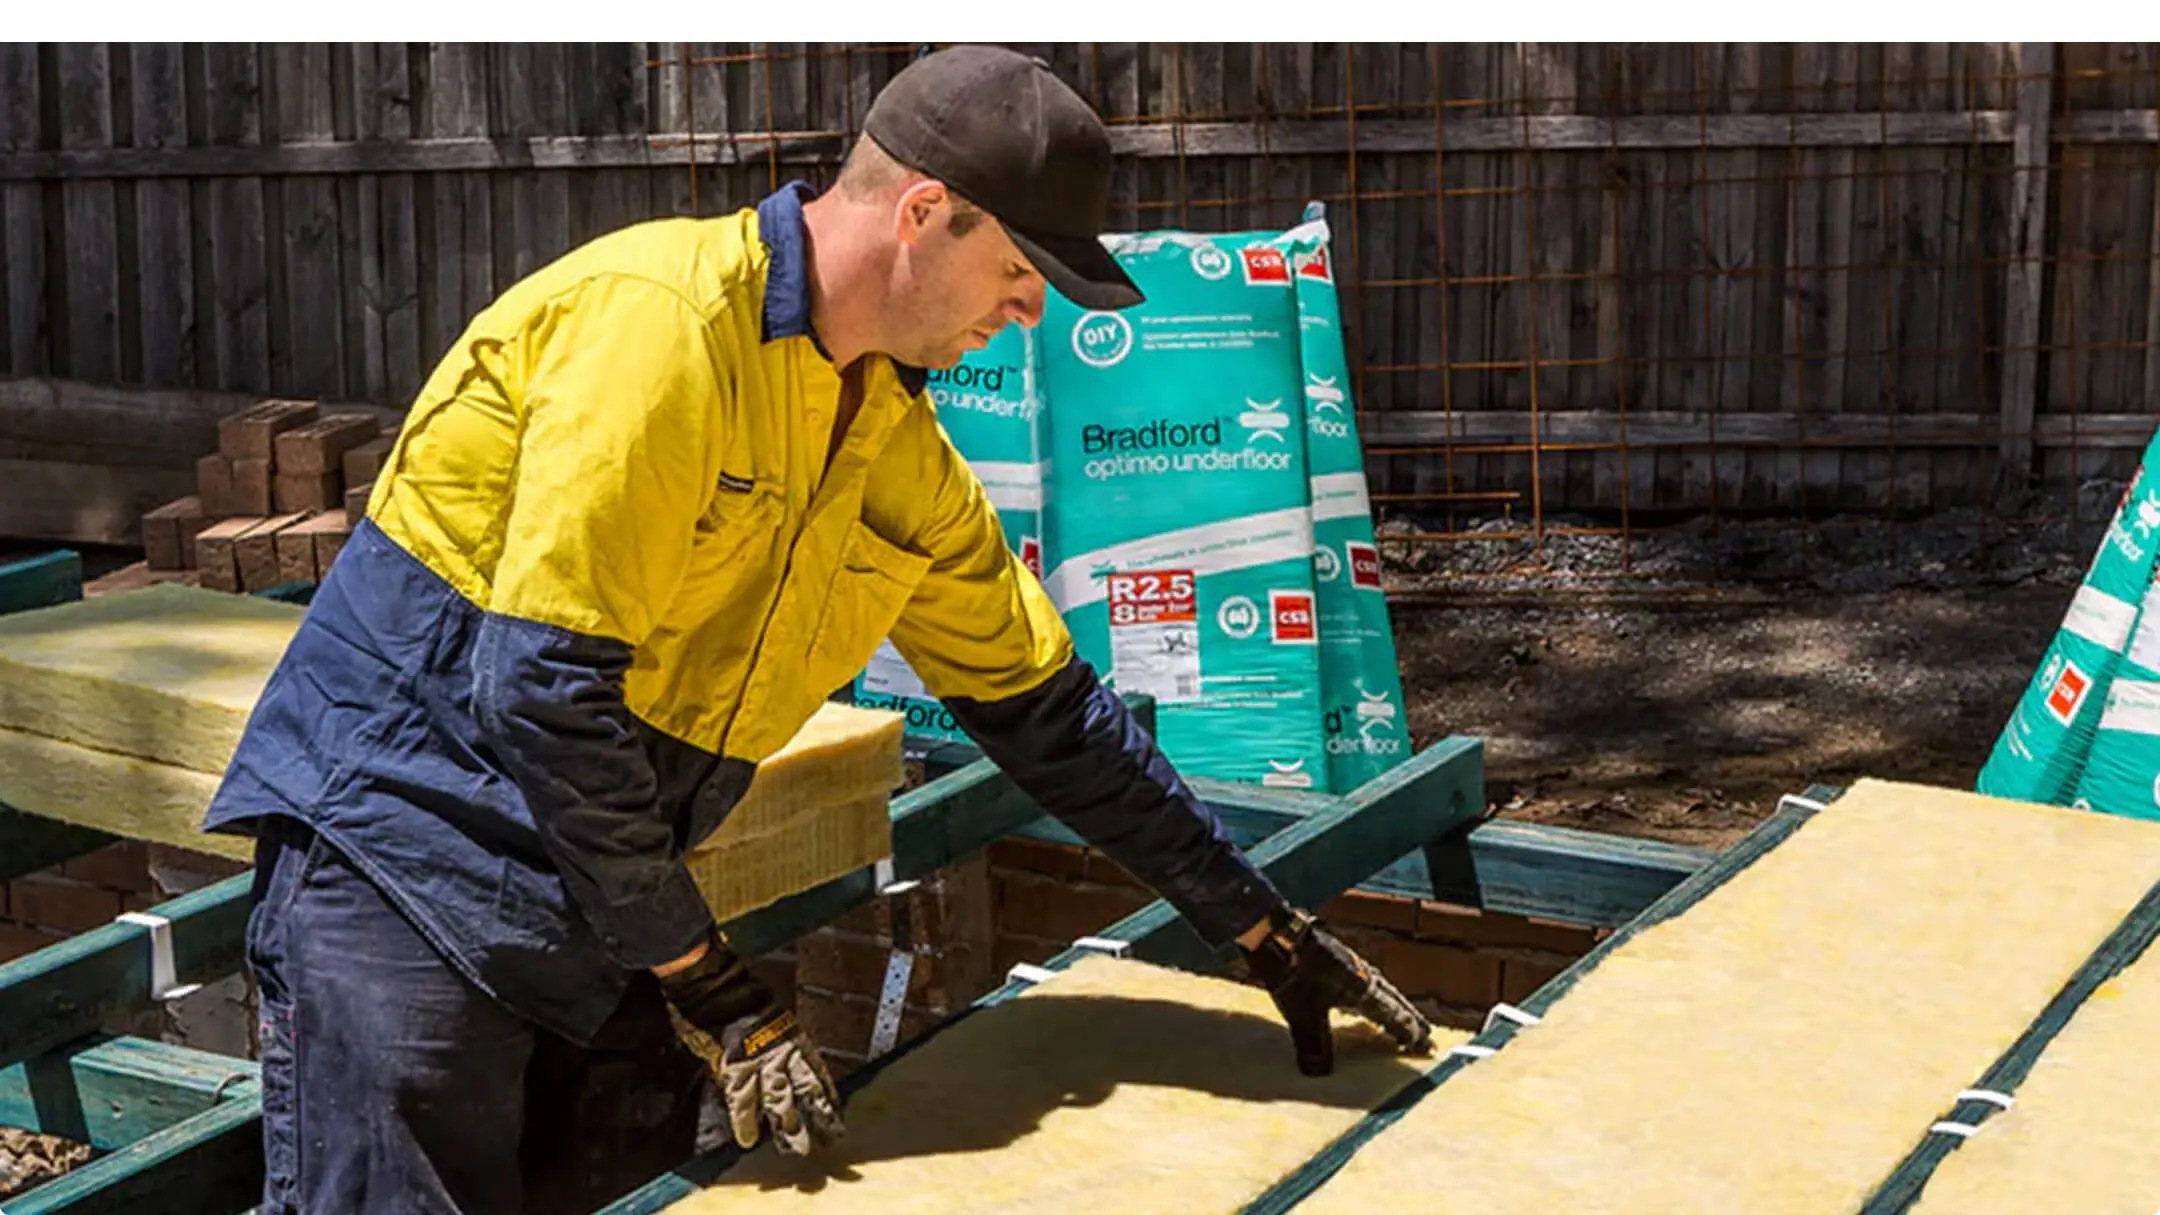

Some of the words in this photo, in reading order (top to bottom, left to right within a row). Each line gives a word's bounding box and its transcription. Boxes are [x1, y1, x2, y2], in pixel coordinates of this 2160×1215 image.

[1082, 322, 1118, 346] DIY
[1082, 416, 1221, 454] Bradford
[1084, 452, 1170, 481] optimo
[1172, 448, 1292, 471] underfloor
[1112, 574, 1193, 603] R2.5
[1114, 603, 1136, 623] 8
